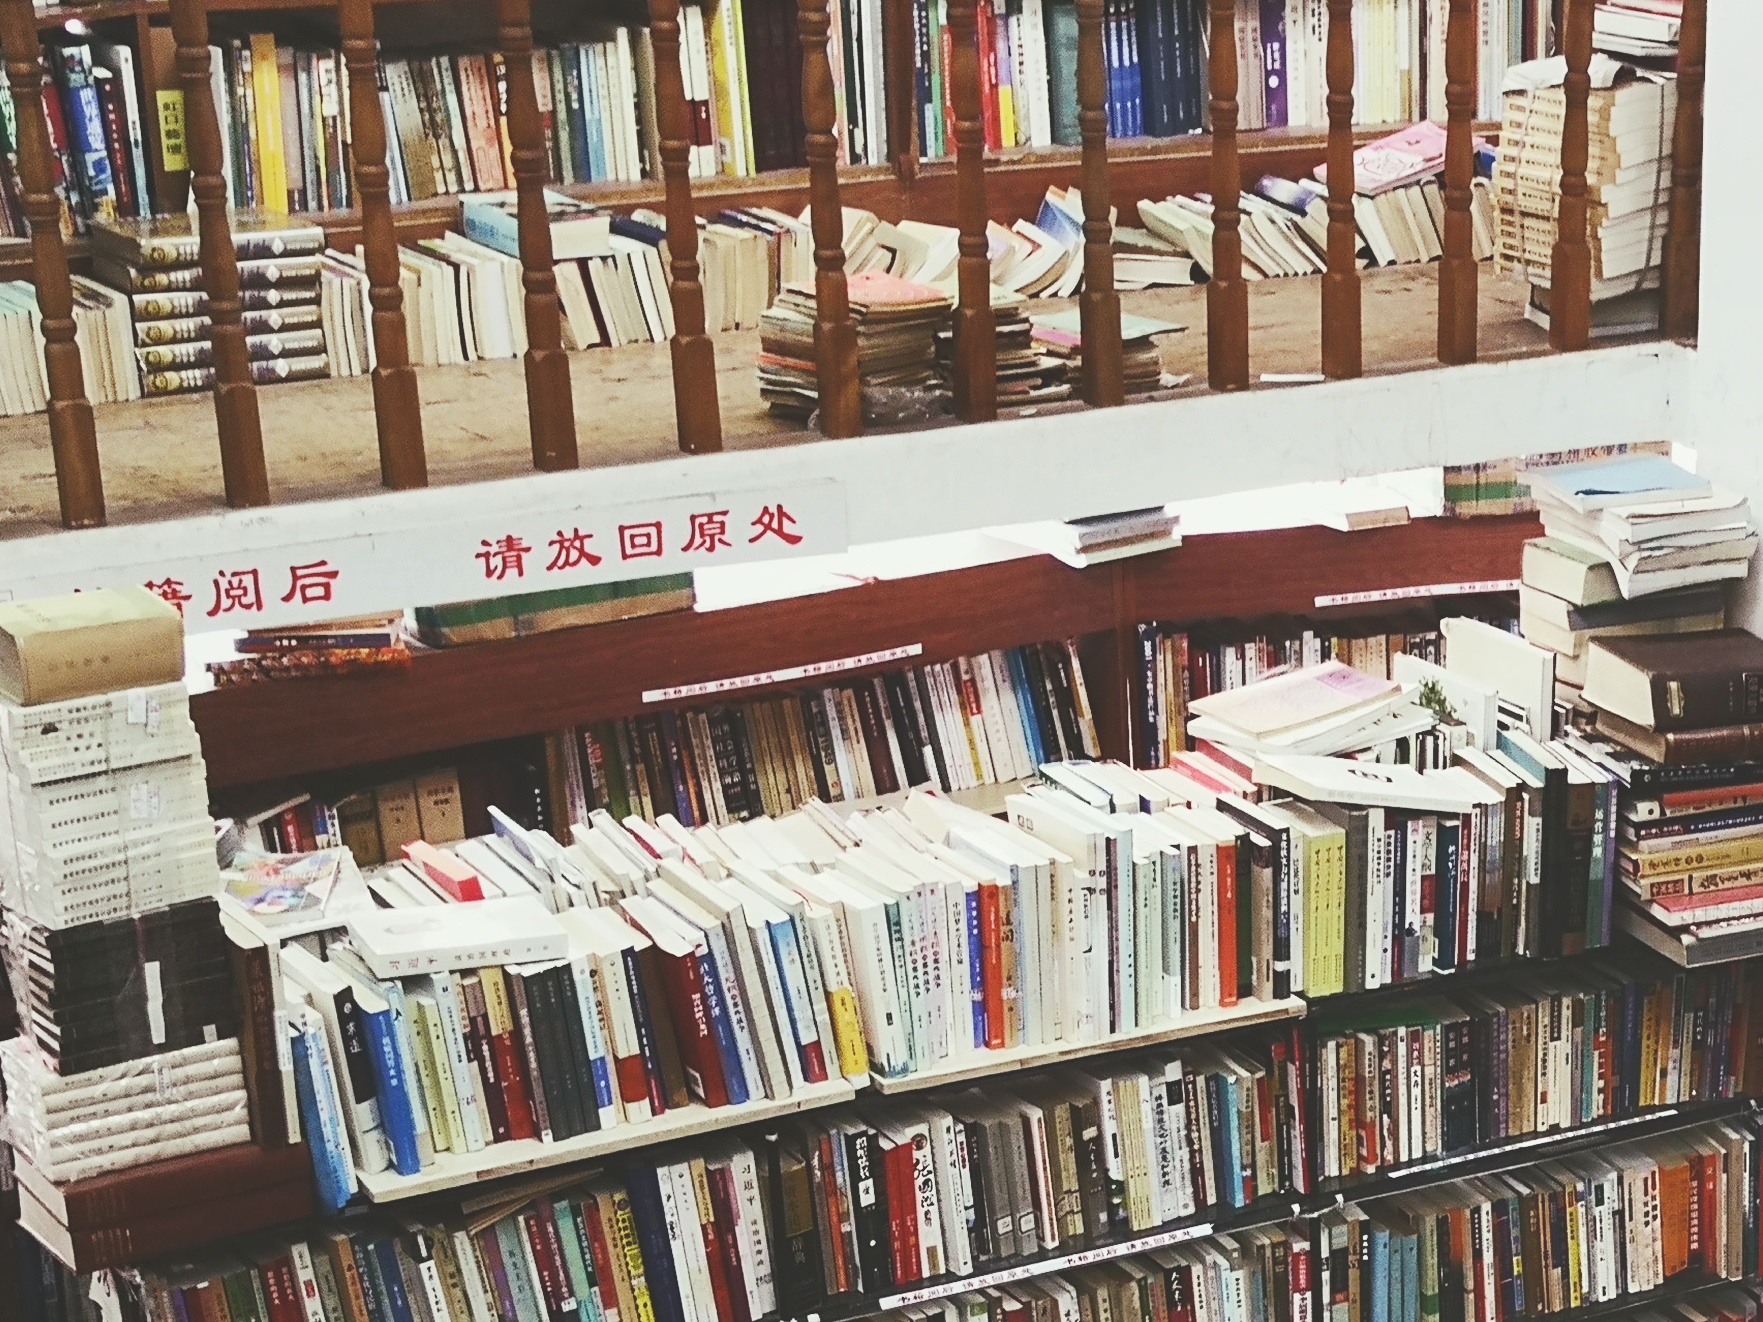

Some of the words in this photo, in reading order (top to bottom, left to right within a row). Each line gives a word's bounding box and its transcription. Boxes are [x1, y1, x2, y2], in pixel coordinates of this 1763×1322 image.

[74, 560, 339, 619] 籍阅后
[476, 503, 804, 584] 请放回原处
